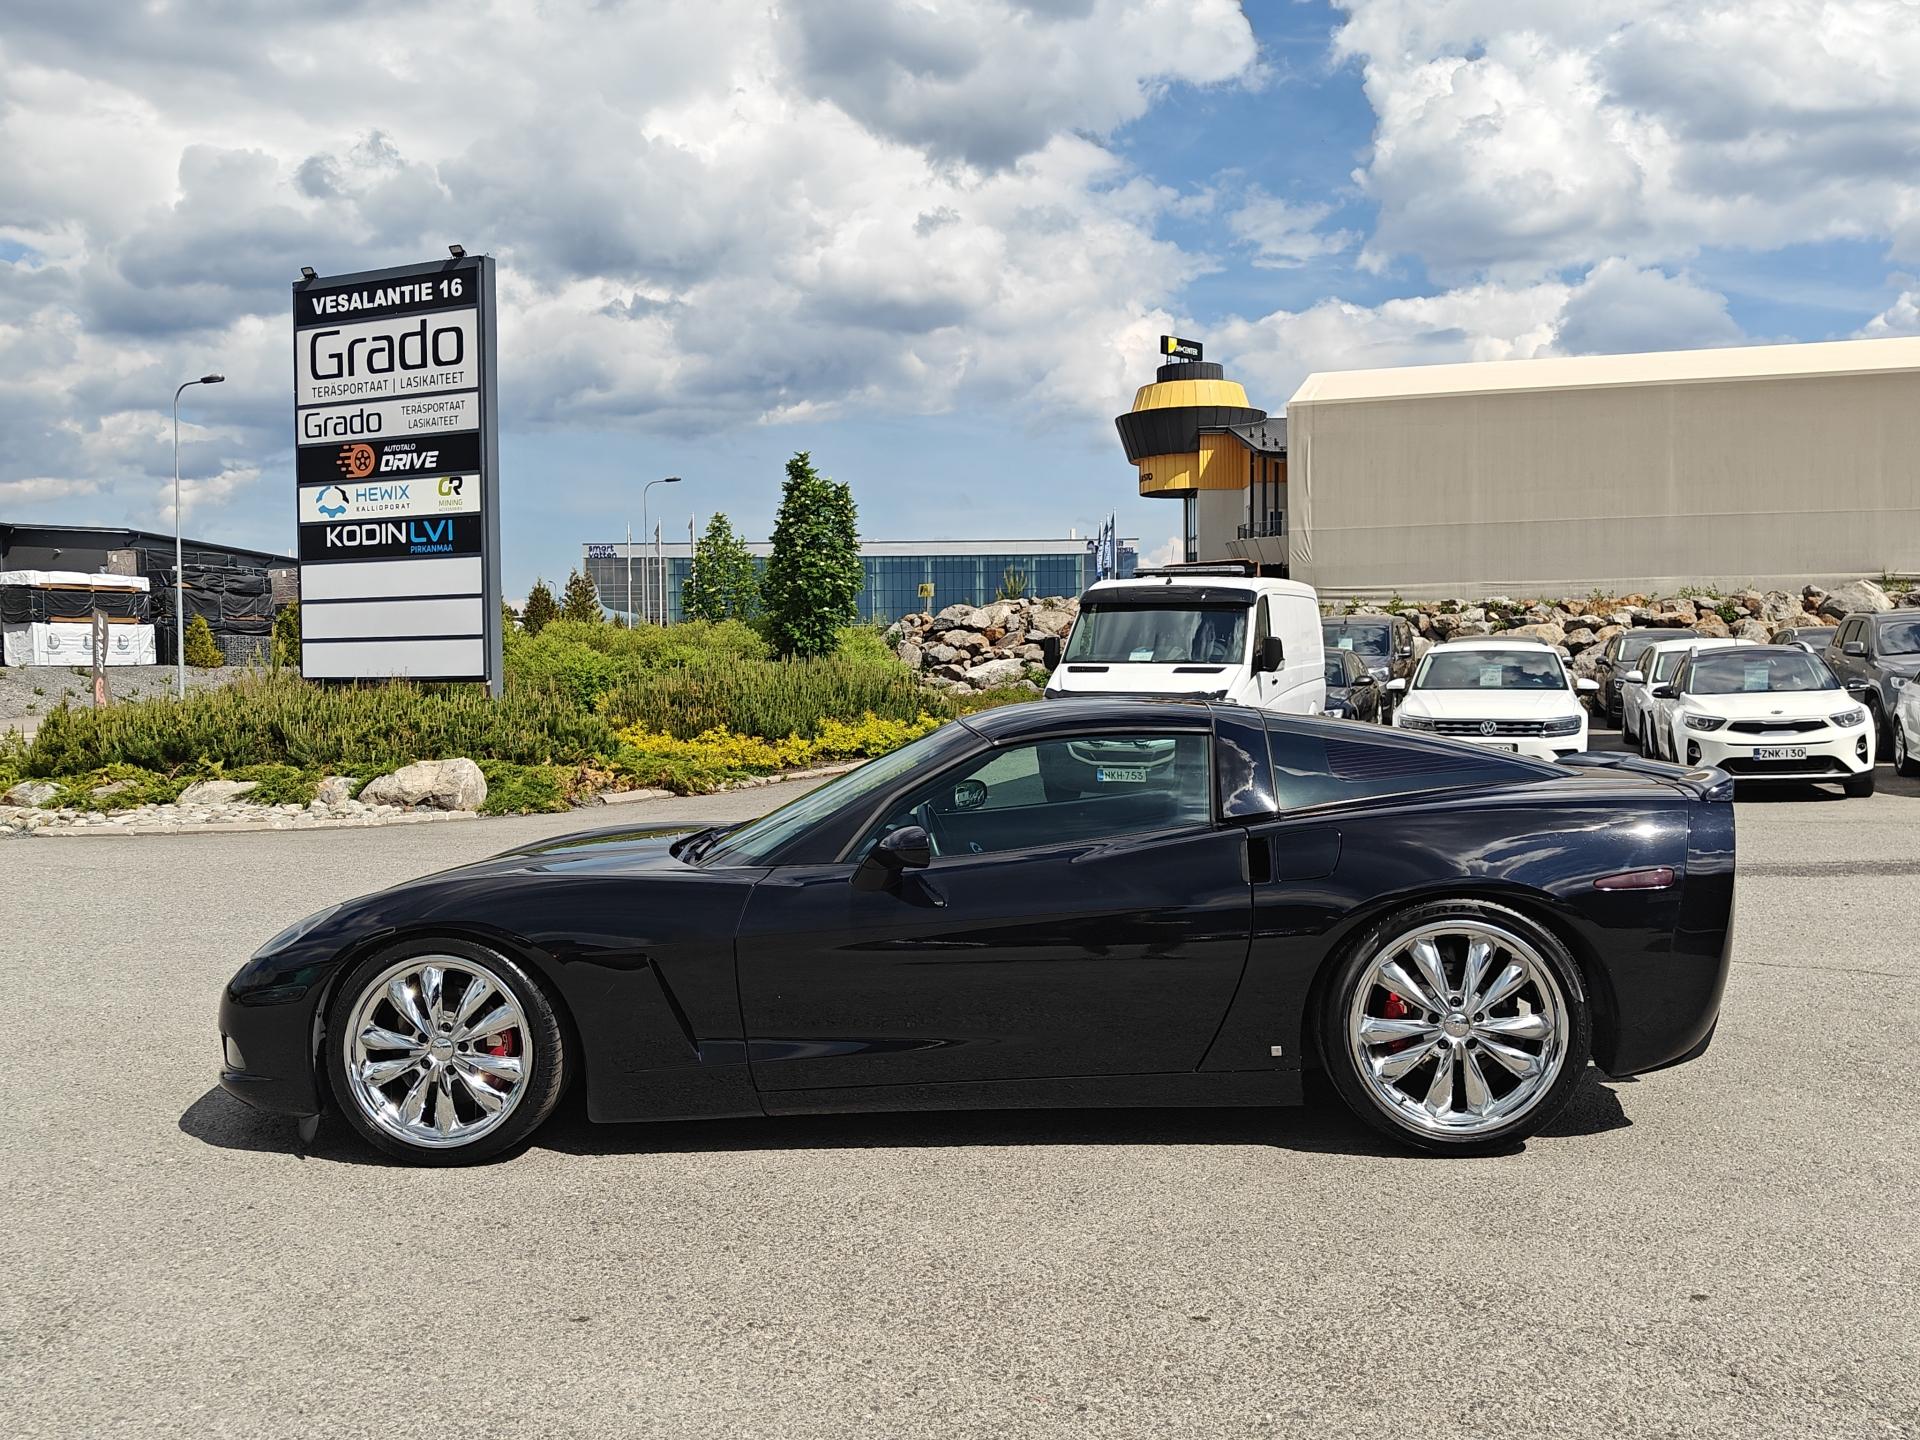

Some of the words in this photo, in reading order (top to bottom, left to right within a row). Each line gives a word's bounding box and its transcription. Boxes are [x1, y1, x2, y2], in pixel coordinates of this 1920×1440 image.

[312, 282, 433, 315] VESALANTIE
[439, 278, 463, 299] 16
[310, 319, 464, 380] Grado
[311, 379, 389, 399] TERÄSPORTAAT
[400, 371, 465, 390] LASIKAITEET
[401, 400, 466, 416] TERÄSPORTAAT
[304, 408, 383, 439] Grado
[407, 415, 460, 430] LASIKAITEET
[383, 443, 416, 453] AUTOTALO
[380, 451, 439, 472] DRIVE
[355, 484, 411, 503] HEWIX
[356, 502, 411, 513] KALLIOPORAT
[438, 498, 463, 507] MINING
[410, 544, 454, 554] PIRKANMAA
[1761, 749, 1804, 759] ZNK-130
[1104, 771, 1144, 781] NKH-753
